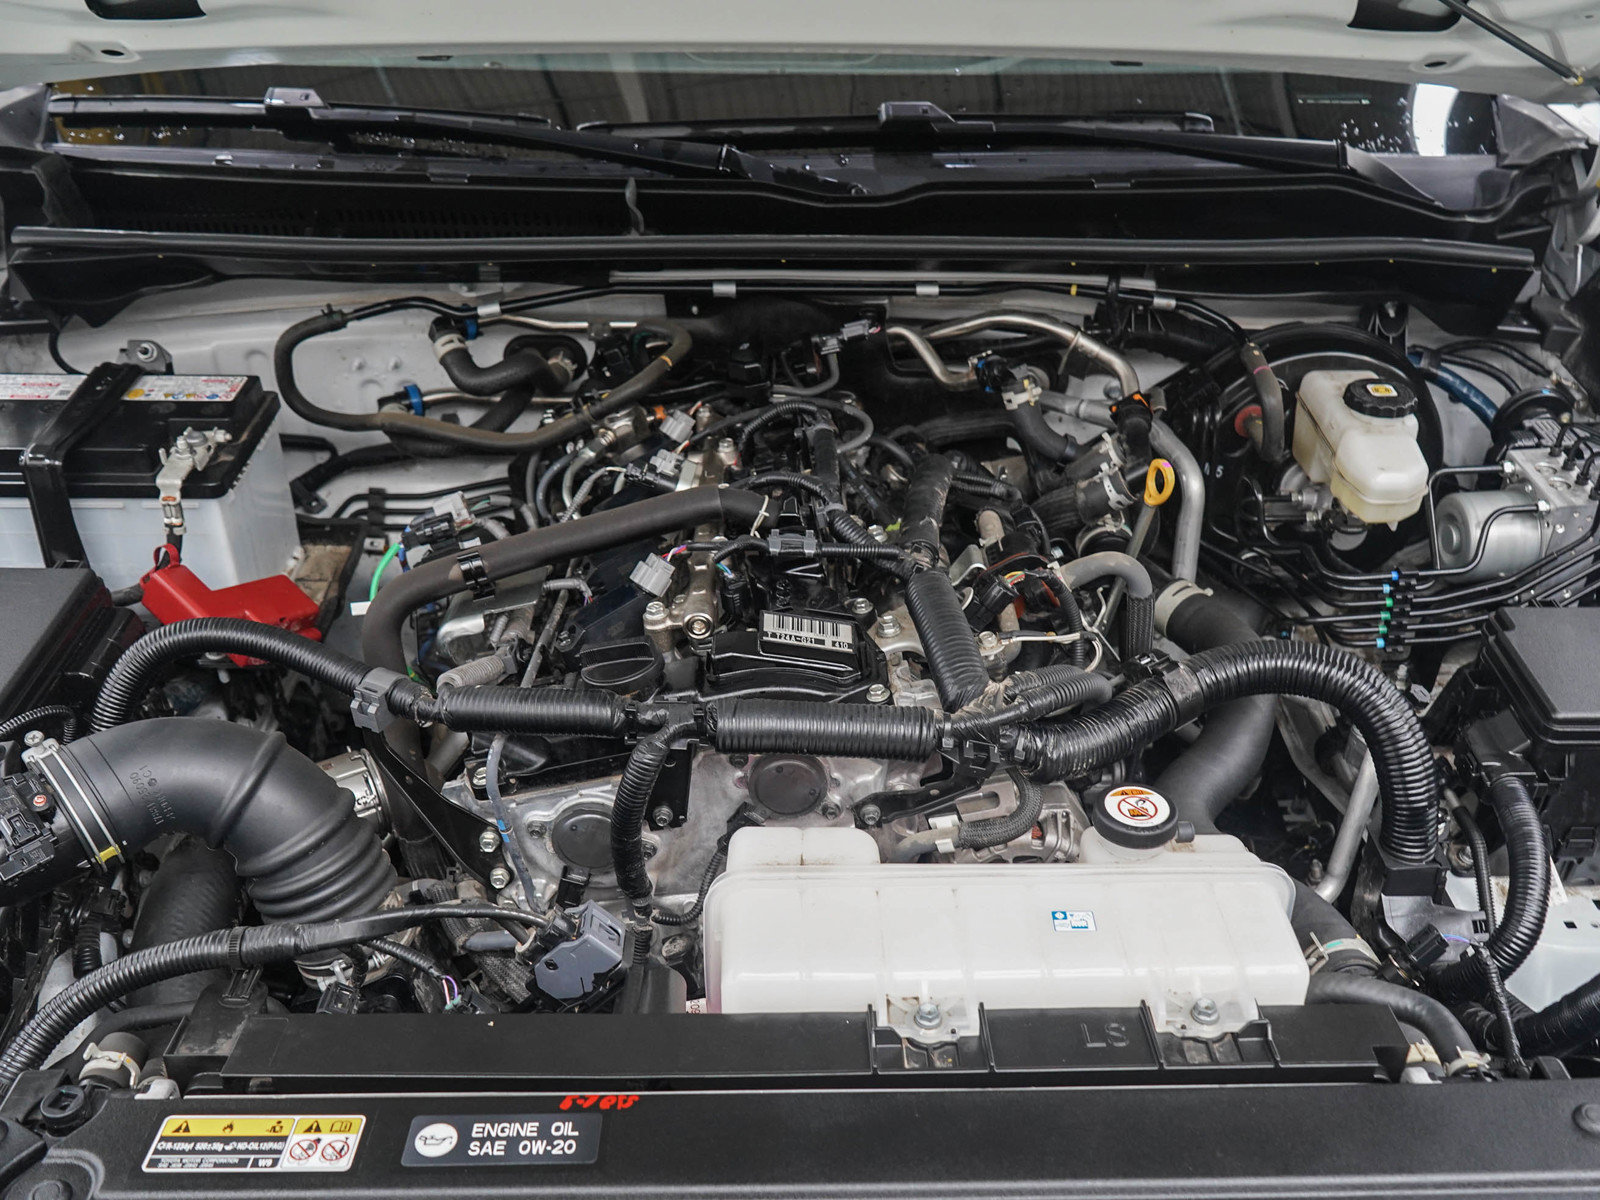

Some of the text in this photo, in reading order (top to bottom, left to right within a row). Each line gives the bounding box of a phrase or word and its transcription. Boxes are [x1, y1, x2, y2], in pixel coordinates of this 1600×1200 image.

[1080, 1022, 1130, 1048] LS
[471, 1121, 580, 1138] ENGINE OIL
[467, 1139, 578, 1157] SAE 0W-20
